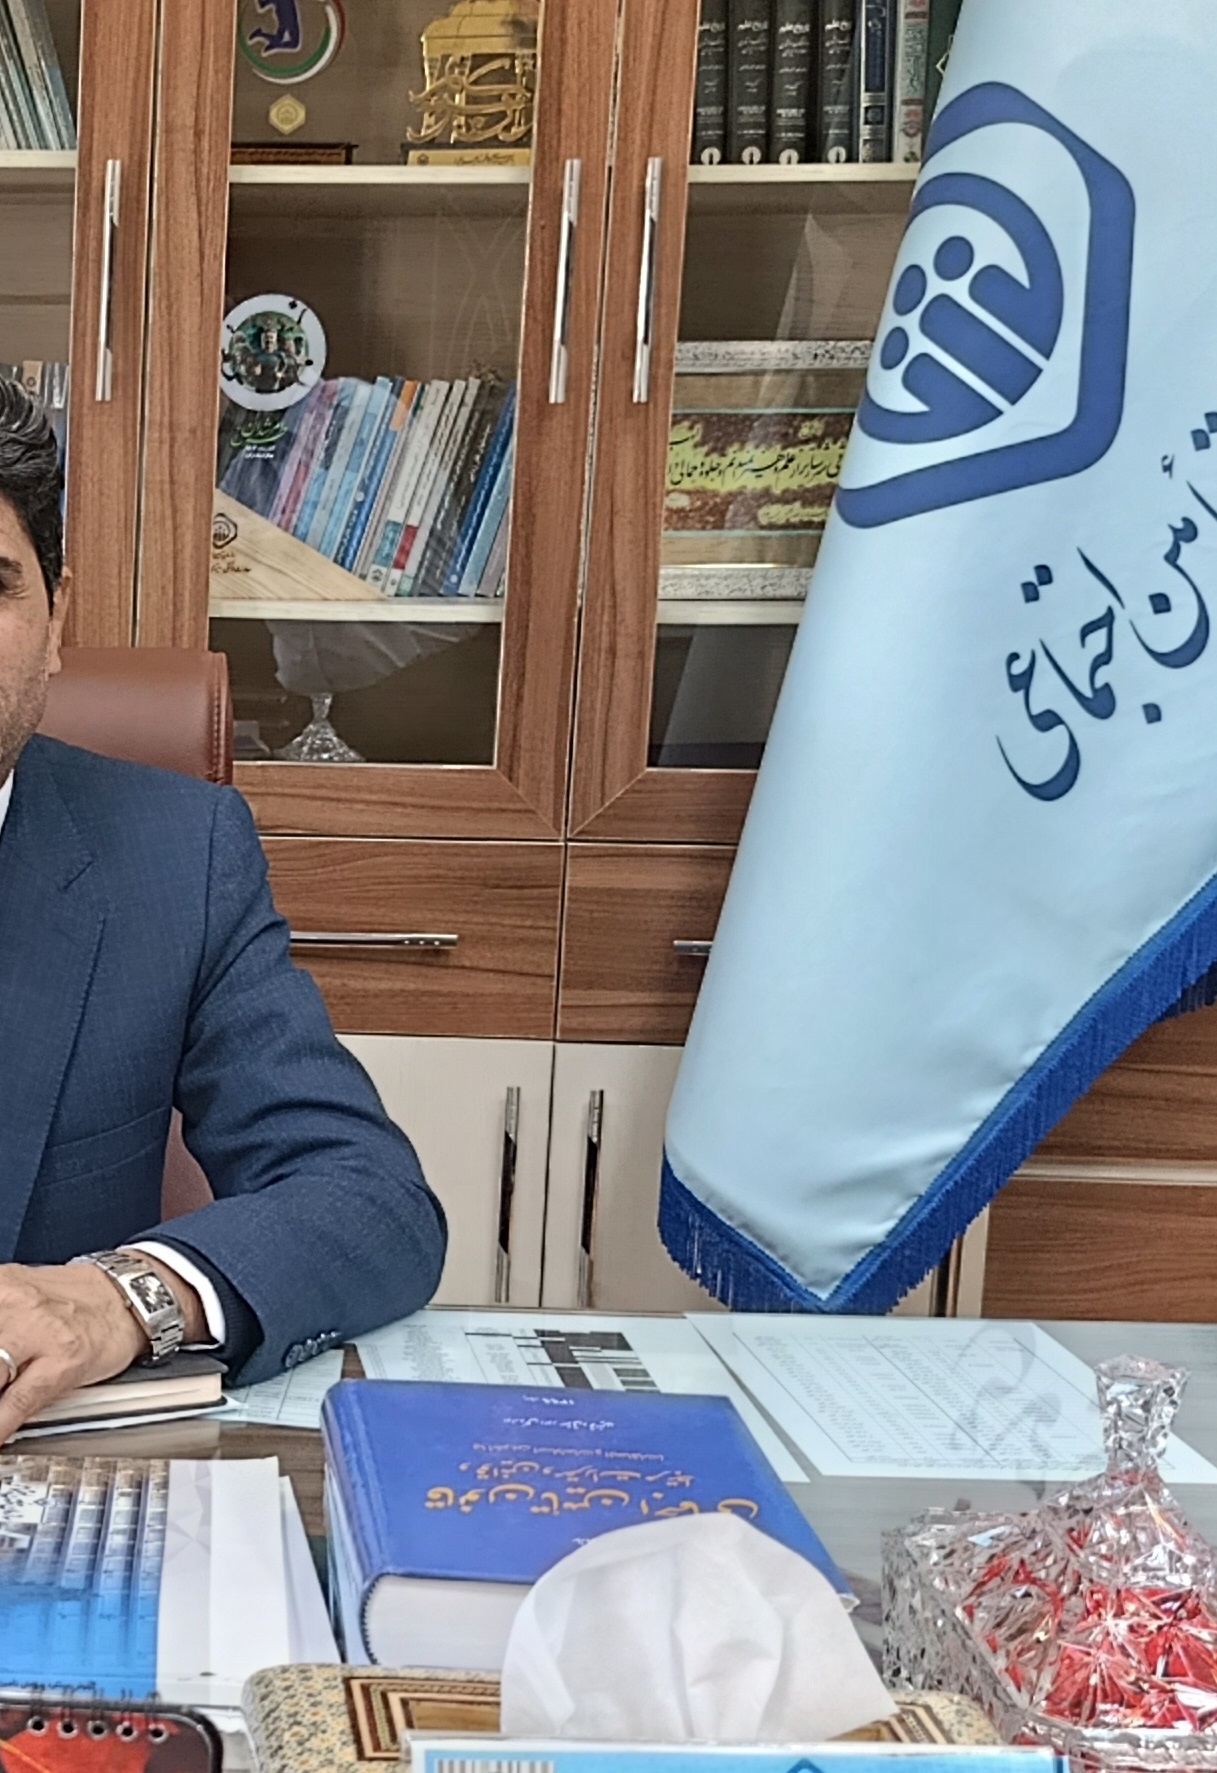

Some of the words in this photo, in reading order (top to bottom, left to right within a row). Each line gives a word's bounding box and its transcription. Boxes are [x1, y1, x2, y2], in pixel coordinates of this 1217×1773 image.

[995, 546, 1162, 802] اجتماعی
[458, 1461, 469, 1472] و
[476, 1459, 540, 1480] قوانین
[542, 1465, 554, 1476] و
[555, 1465, 641, 1482] مقررات
[645, 1470, 694, 1488] مرتبط
[424, 1482, 535, 1514] قانون
[640, 1490, 760, 1520] اجتمای
